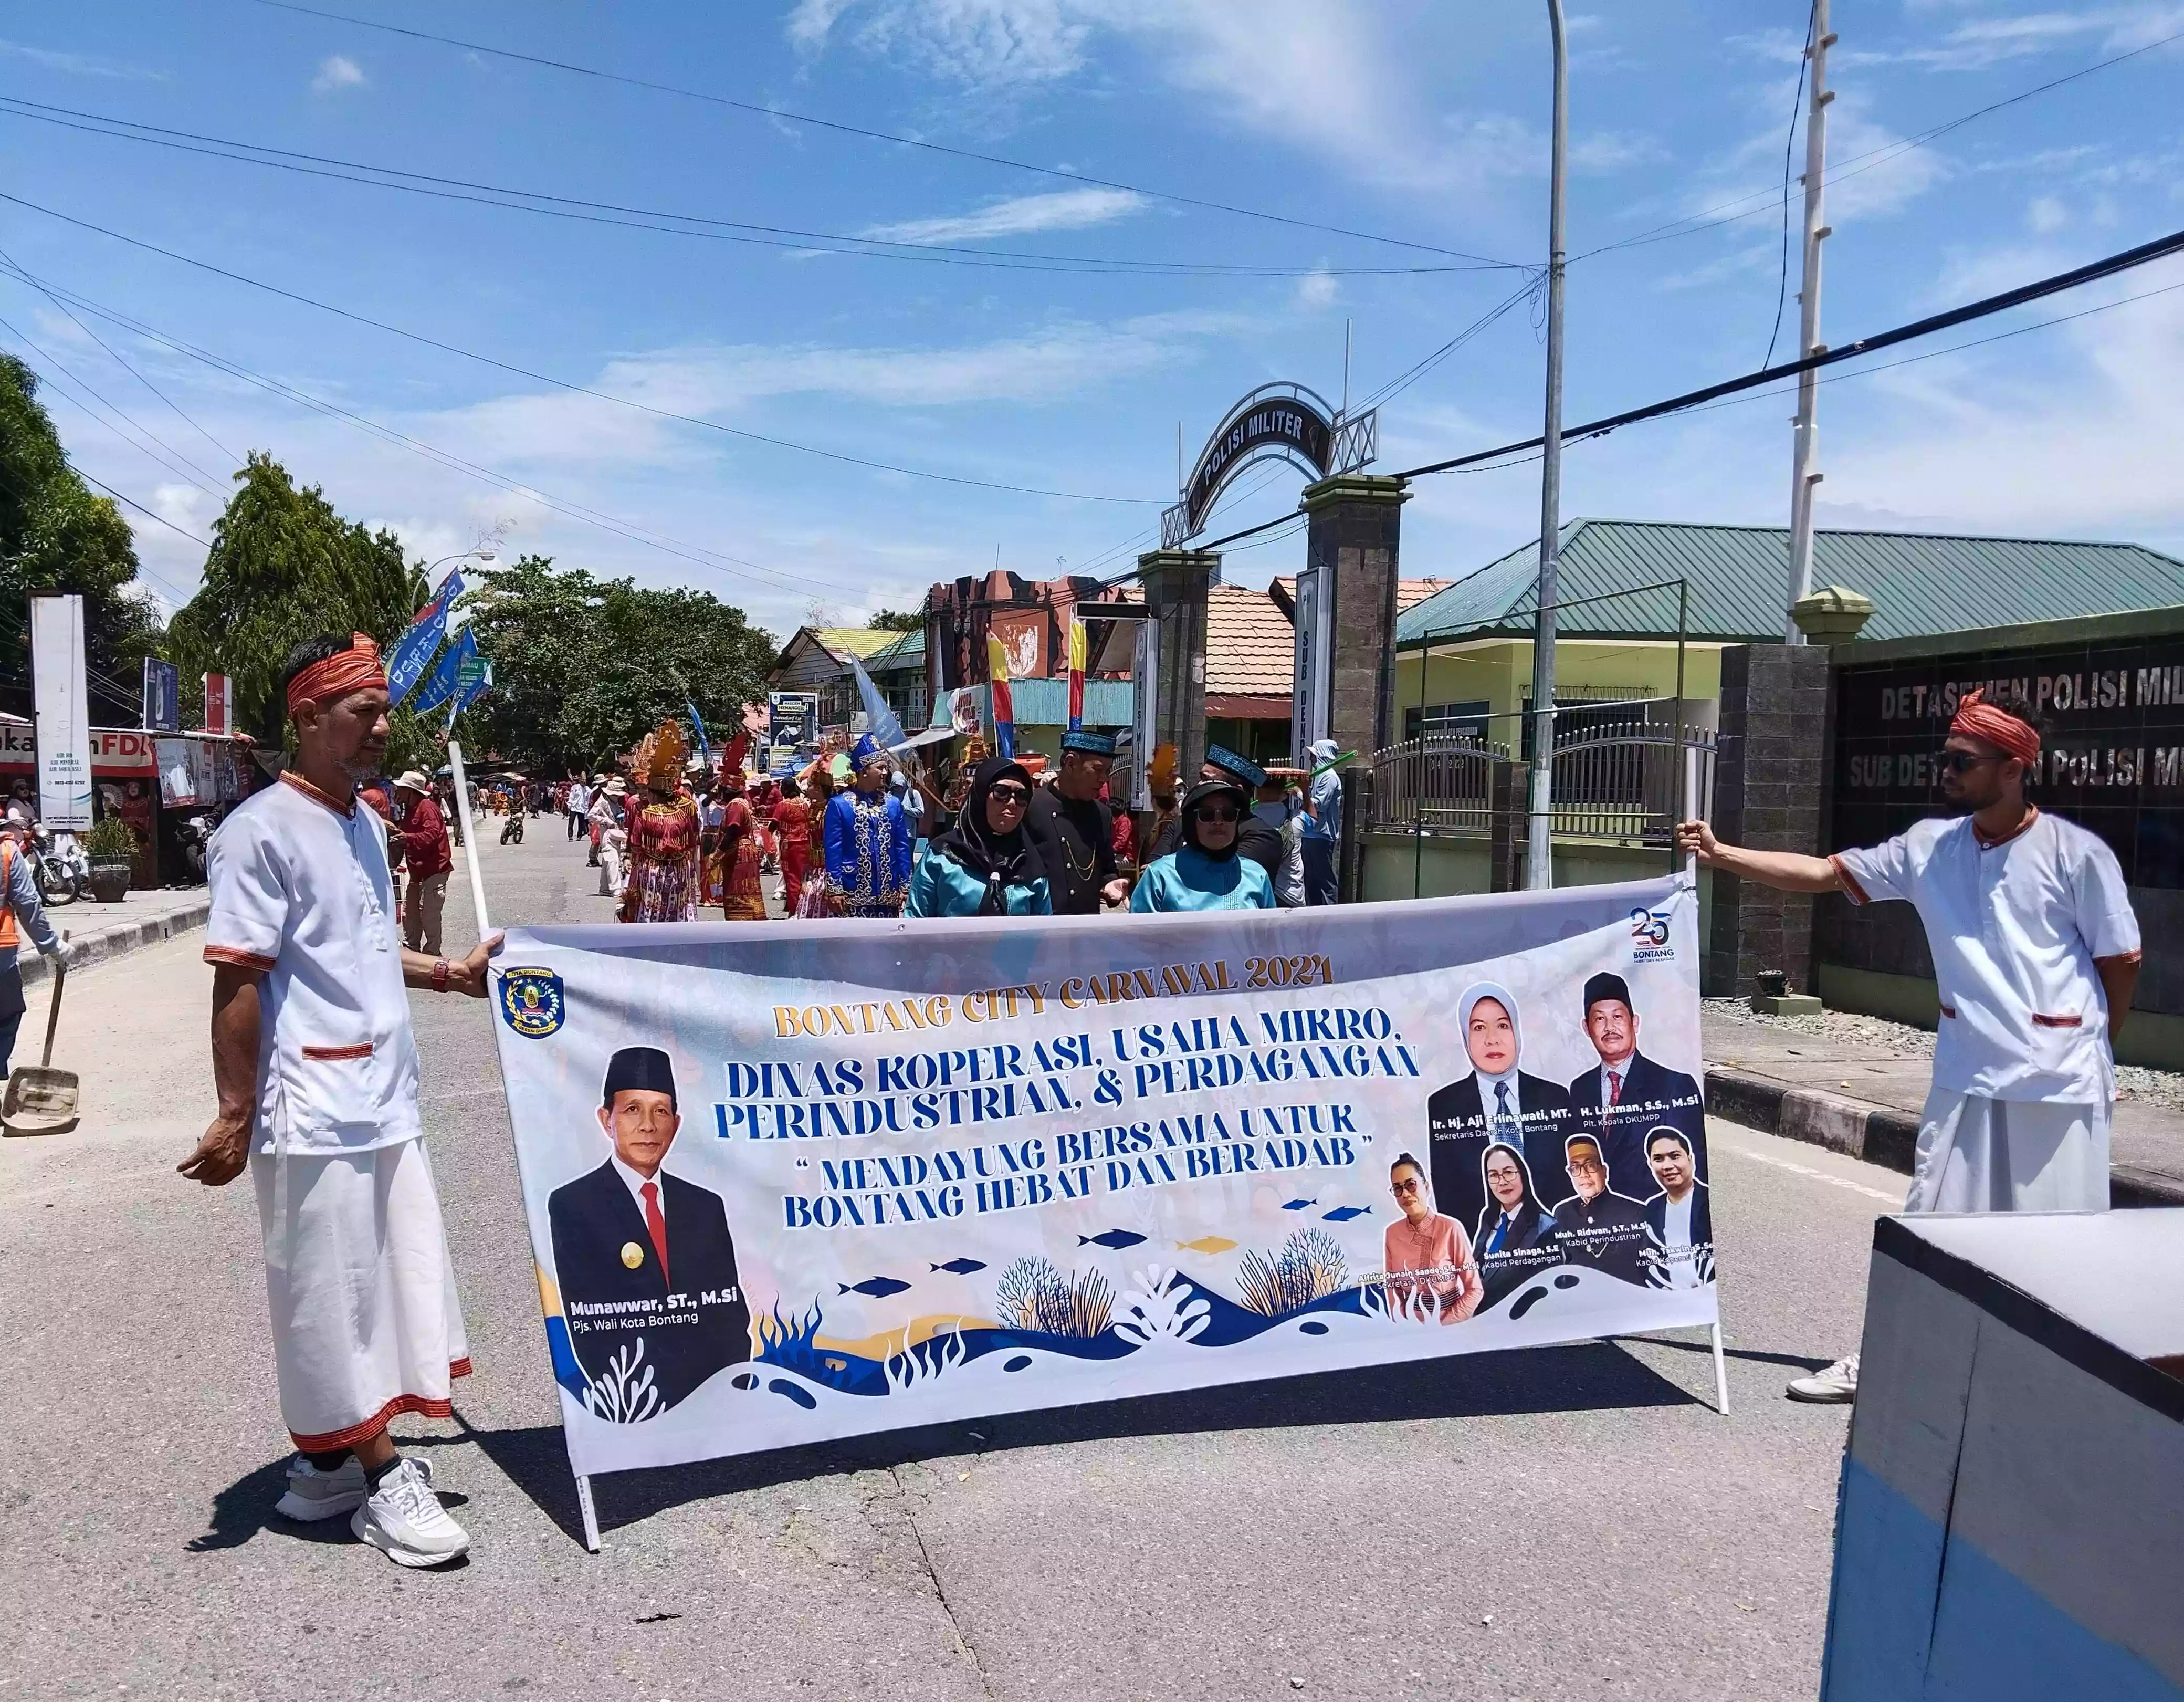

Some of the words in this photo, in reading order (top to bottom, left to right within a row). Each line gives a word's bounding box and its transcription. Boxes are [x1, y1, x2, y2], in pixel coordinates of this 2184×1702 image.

[1204, 424, 1244, 487] POLISI
[1248, 410, 1303, 441] MILITER
[2036, 671, 2128, 712] POLISI
[1299, 690, 1307, 771] DENPO
[1850, 754, 1892, 787] SUB
[2052, 748, 2145, 786] POLISI
[1633, 949, 1674, 959] BONTANG
[773, 996, 952, 1037] BONTANG
[961, 981, 1049, 1024] CITY
[1060, 960, 1238, 1009] CARNAVAL
[1245, 954, 1334, 987] 2024
[727, 1059, 864, 1099] DINAS
[877, 1032, 1102, 1093] KOPERASI,
[1111, 1014, 1250, 1062] USAHA
[1259, 1007, 1401, 1043] MIKRO,
[713, 1075, 1082, 1139] PERINDUSTRIAN,
[1093, 1068, 1125, 1110] &
[1134, 1044, 1420, 1098] PERDAGANGAN
[1580, 1107, 1593, 1116] H.
[1595, 1103, 1643, 1115] Lukman,
[1645, 1100, 1670, 1111] S.S.,
[1672, 1094, 1699, 1108] M.Si
[1432, 1120, 1445, 1130] Ir.
[1448, 1118, 1464, 1131] Hj.
[1467, 1116, 1483, 1129] Aji
[1486, 1109, 1549, 1125] Erlinawati,
[1550, 1109, 1572, 1119] MT.
[1599, 1117, 1624, 1127] Kepala
[1625, 1114, 1660, 1124] DKUMPP
[1056, 1112, 1232, 1167] BERSAMA
[1240, 1104, 1358, 1139] UNTUK
[1434, 1132, 1474, 1141] Sekretaris
[1475, 1129, 1503, 1137] Daerah
[1505, 1126, 1522, 1135] Kota
[1525, 1123, 1558, 1133] Bontang
[785, 1186, 964, 1228] BONTANG
[975, 1165, 1095, 1213] HEBAT
[1107, 1153, 1177, 1193] DAN
[1555, 1230, 1575, 1240] Muh.
[1577, 1227, 1611, 1237] Ridwan,
[1631, 1221, 1647, 1230] M.Si
[1589, 1233, 1641, 1244] Perindustrian
[1483, 1251, 1511, 1260] Sunita
[1513, 1248, 1545, 1258] Sinaga,
[1484, 1260, 1507, 1269] Kabid
[1509, 1255, 1561, 1266] Perdagangan
[1636, 1258, 1658, 1267] Kabid
[1462, 1261, 1479, 1270] M.Si
[1377, 1279, 1418, 1289] Sekretaris
[1419, 1273, 1456, 1285] DKUMPP
[570, 1297, 663, 1317] Munawwar,
[666, 1293, 697, 1309] ST.,
[701, 1286, 738, 1306] M.Si
[573, 1320, 592, 1334] Pjs.
[594, 1318, 617, 1331] Wali
[621, 1317, 645, 1329] Kota
[648, 1312, 699, 1326] Bontang
